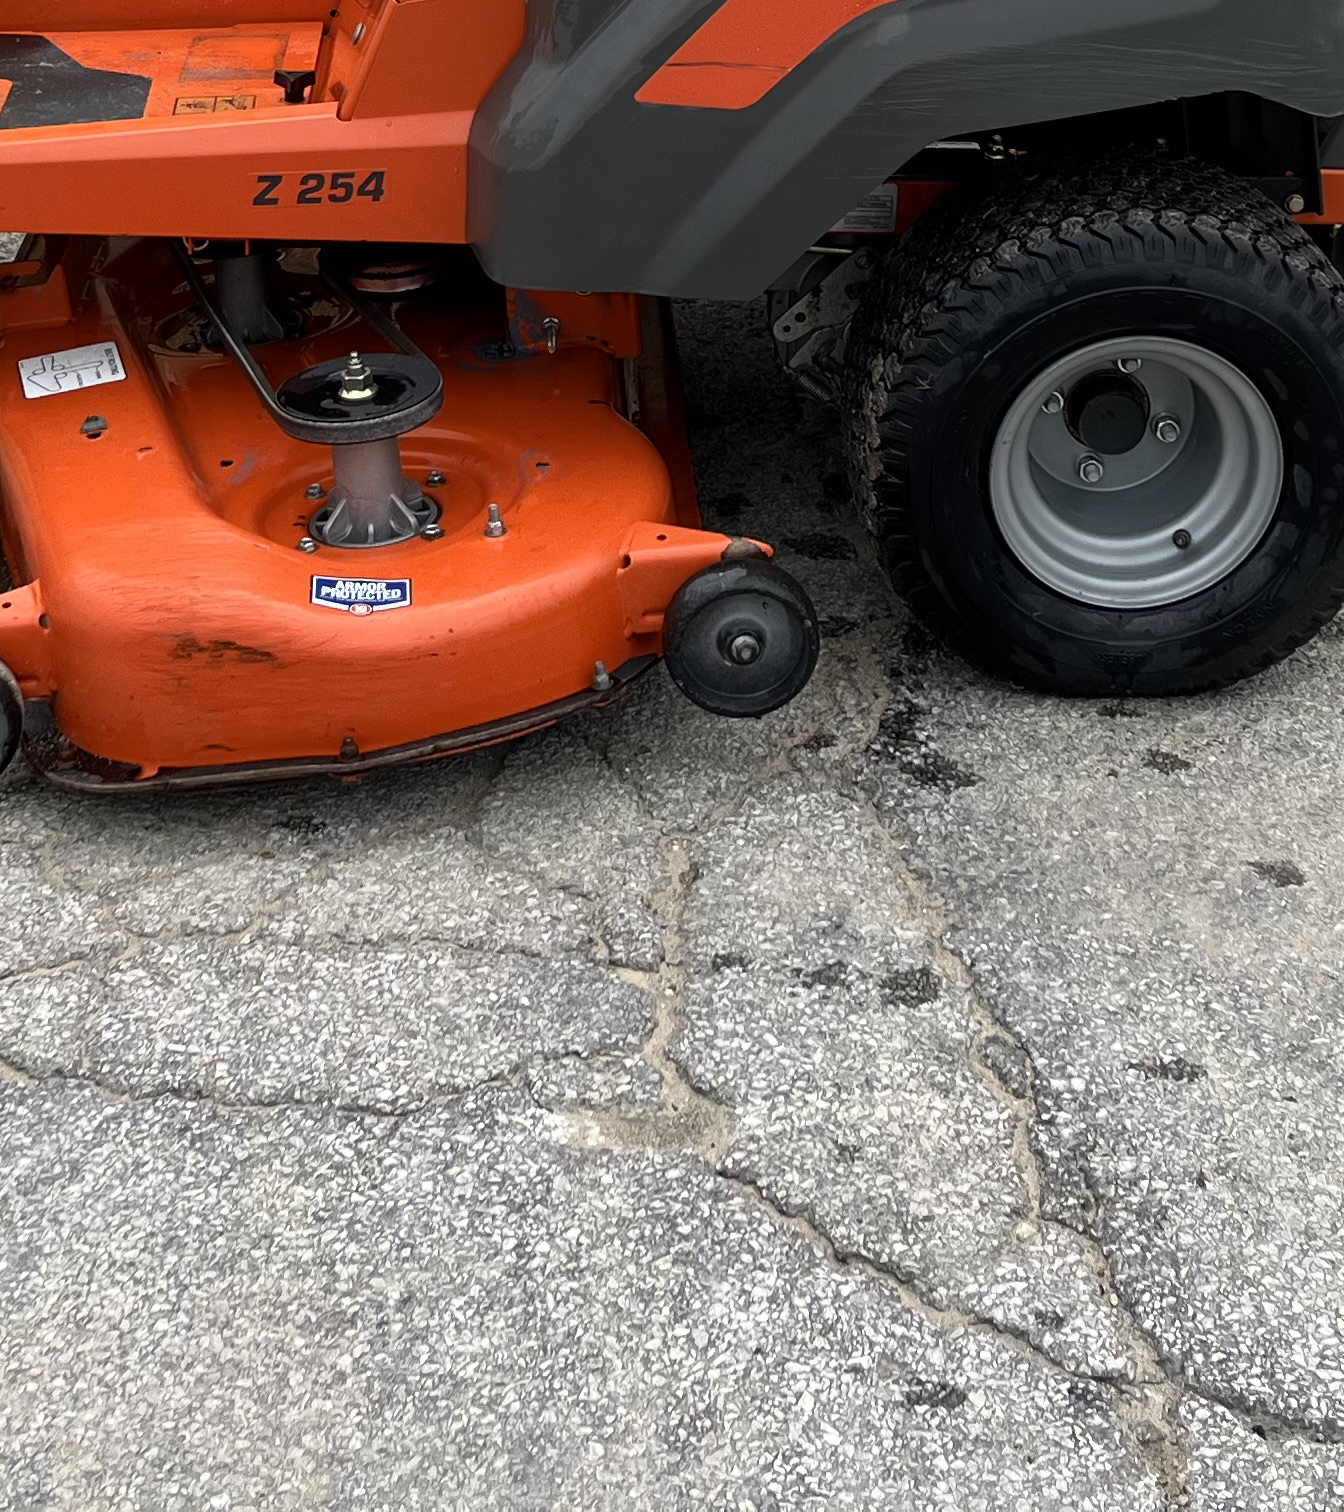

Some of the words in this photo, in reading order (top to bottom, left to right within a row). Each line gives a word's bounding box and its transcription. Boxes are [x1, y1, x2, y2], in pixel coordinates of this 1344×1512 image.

[252, 175, 283, 206] Z
[296, 171, 386, 204] 254
[320, 585, 402, 601] PROTECTED
[336, 580, 387, 595] ARMOR
